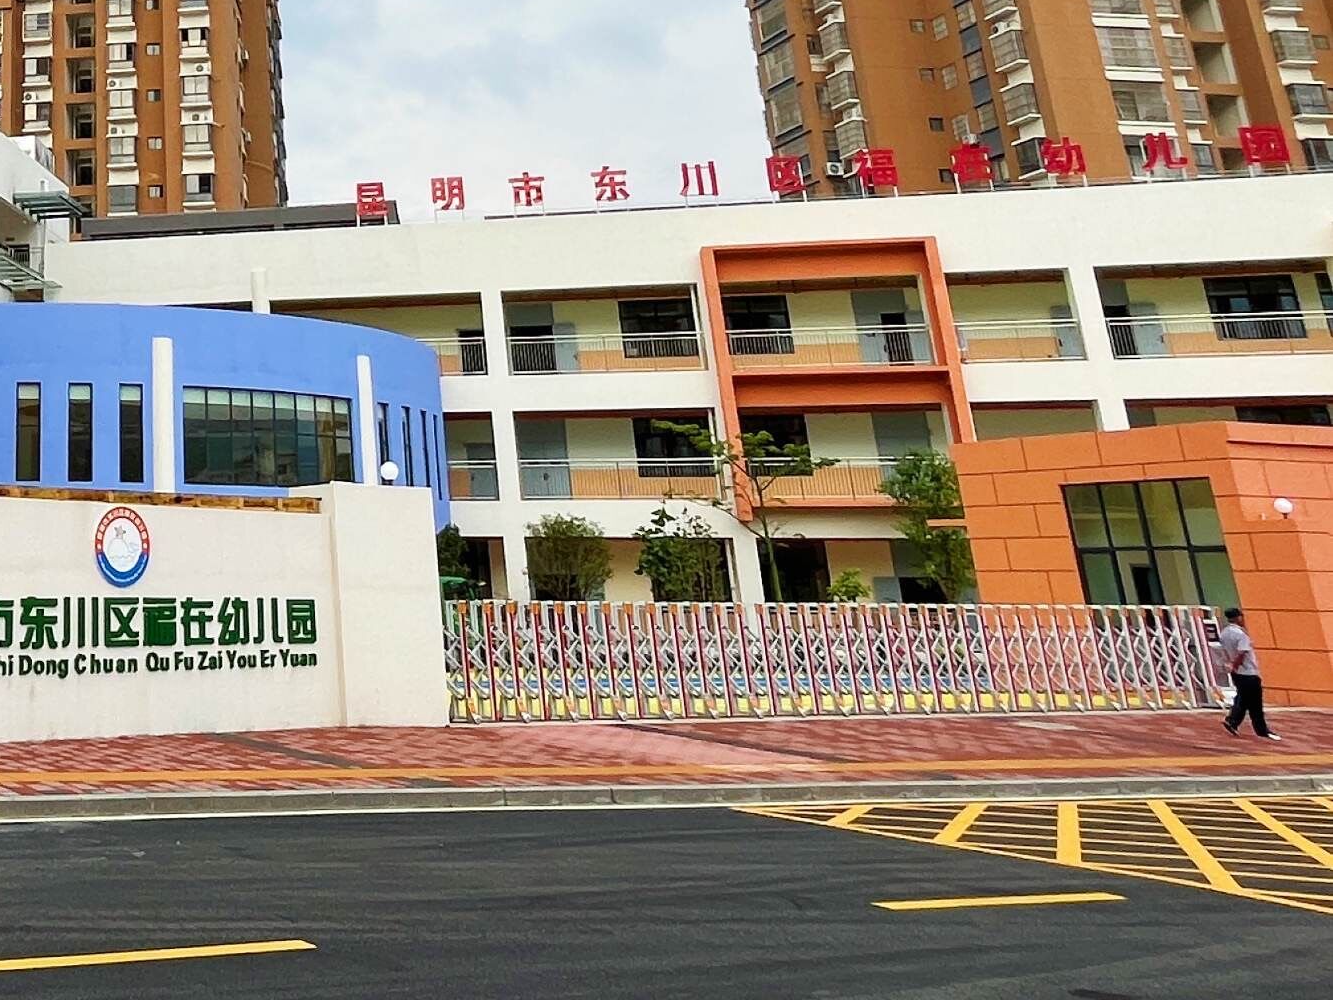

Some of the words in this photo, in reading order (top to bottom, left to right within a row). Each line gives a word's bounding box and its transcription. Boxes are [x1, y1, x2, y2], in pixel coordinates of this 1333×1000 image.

[18, 654, 69, 680] Dong
[73, 653, 139, 676] Chuan
[145, 651, 170, 673] Qu
[174, 651, 194, 672] Fu
[197, 650, 223, 671] Zai
[225, 649, 257, 670] You
[259, 649, 277, 669] Er
[278, 648, 318, 668] Yuan
